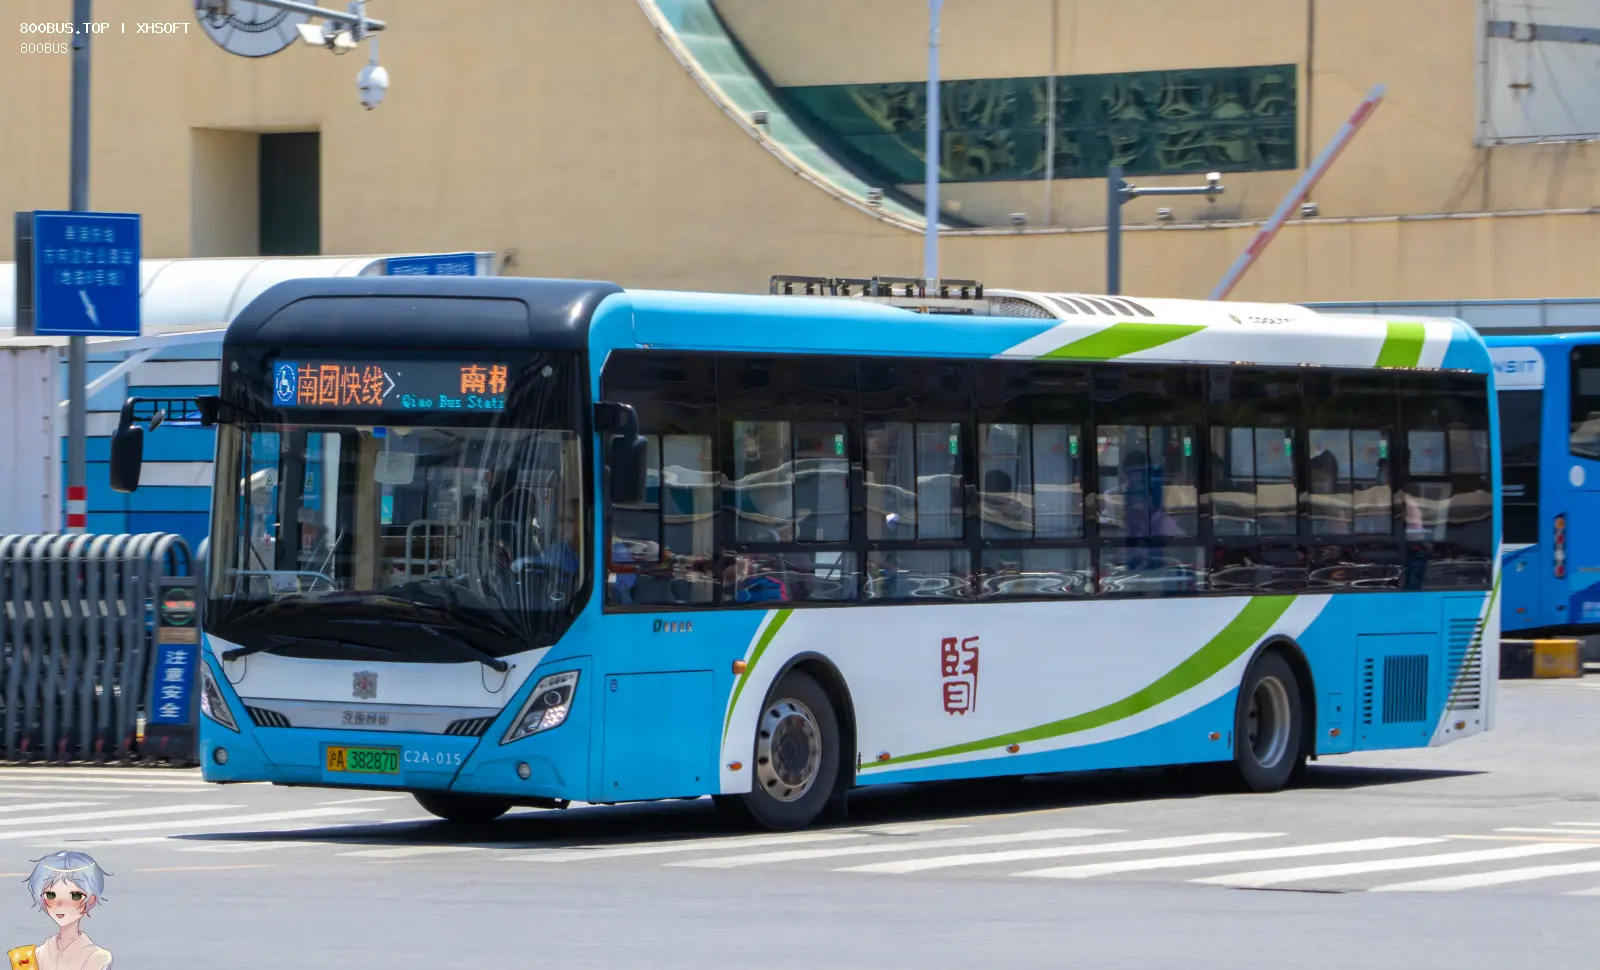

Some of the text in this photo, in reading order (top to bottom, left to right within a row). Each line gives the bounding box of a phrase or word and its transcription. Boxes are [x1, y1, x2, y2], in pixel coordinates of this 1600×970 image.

[298, 363, 384, 407] 南团快线
[401, 394, 433, 409] Qiao
[439, 395, 462, 408] Bus
[158, 649, 189, 718] 注意安全
[351, 750, 398, 771] 38287D
[403, 750, 461, 766] C2A-015
